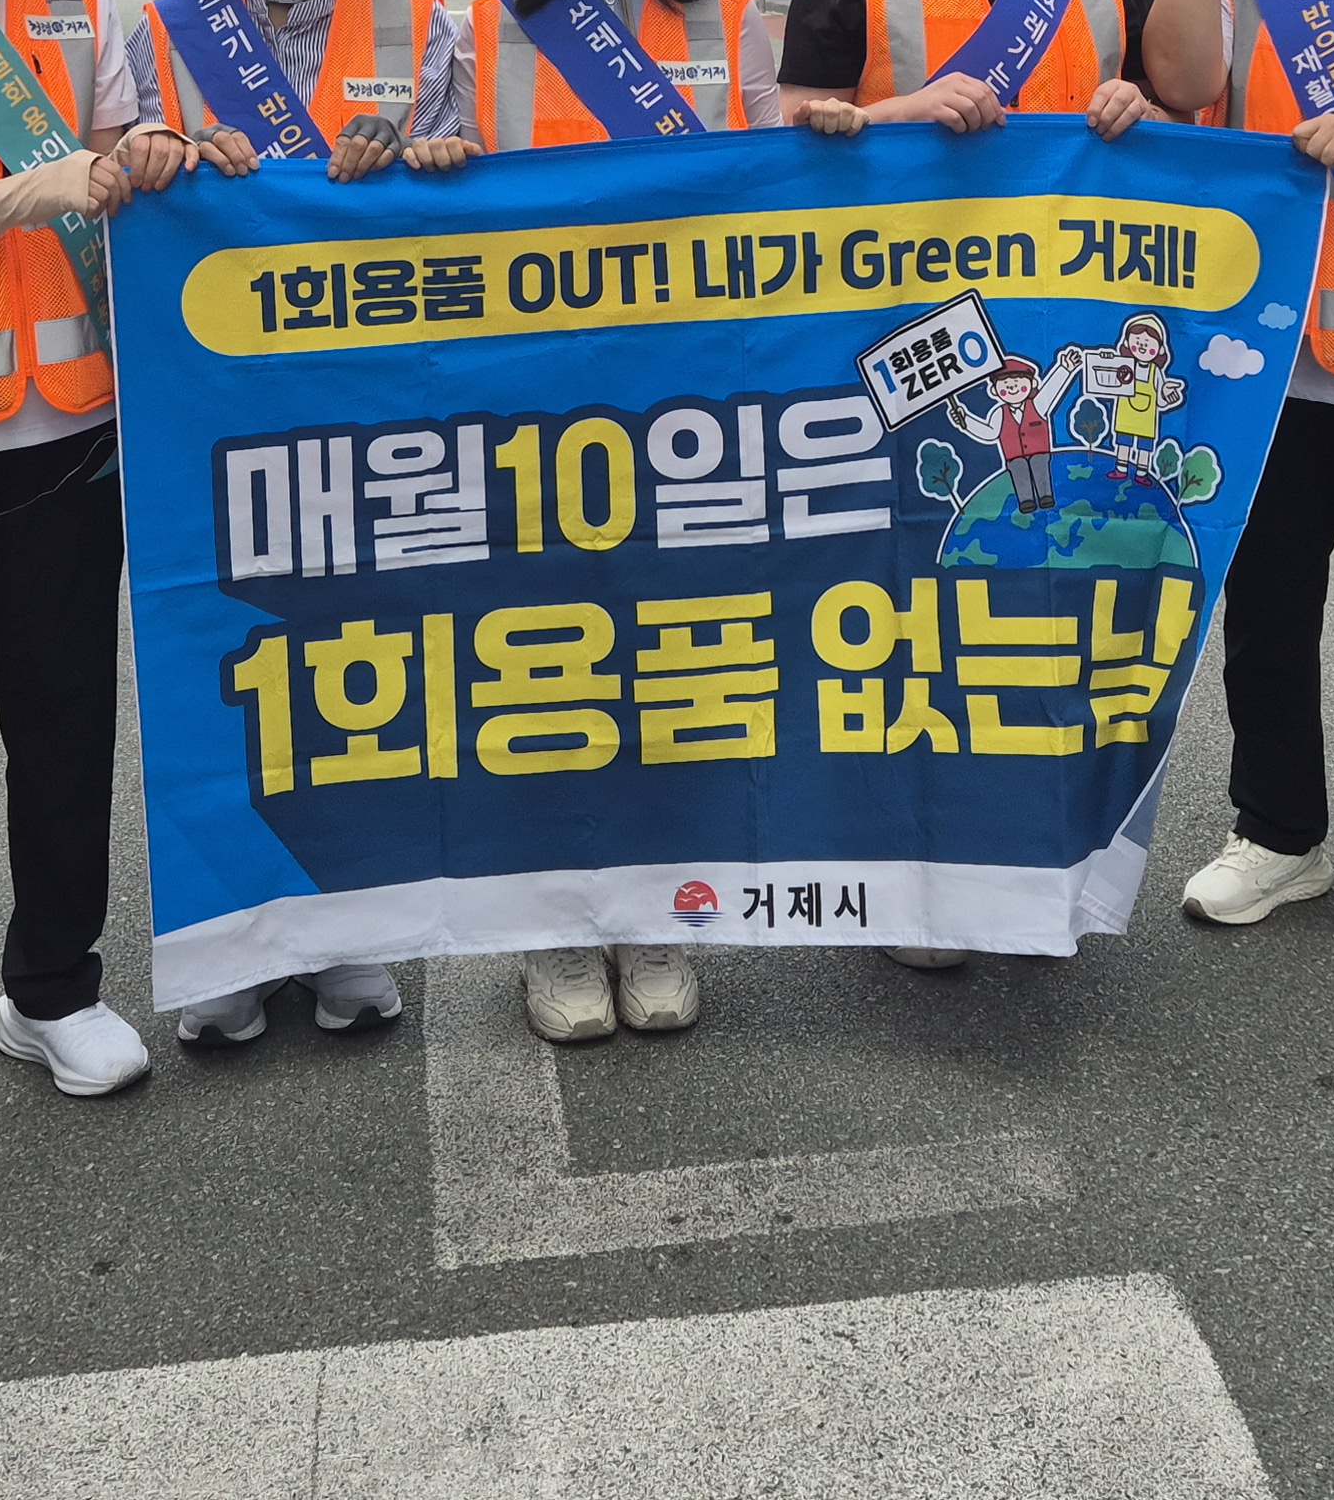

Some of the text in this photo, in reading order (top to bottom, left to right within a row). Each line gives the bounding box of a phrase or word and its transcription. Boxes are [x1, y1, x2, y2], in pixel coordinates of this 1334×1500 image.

[64, 21, 91, 34] 거제
[567, 4, 665, 110] 쓰레기는
[388, 84, 412, 99] 거제
[701, 67, 726, 80] 거제
[257, 91, 319, 159] 반으
[250, 219, 1199, 336] 1회용품 OUT! 내가 Green 거제!
[873, 327, 953, 395] 1회용품
[900, 330, 989, 401] ZERO
[226, 393, 891, 581] 매월10일은
[233, 591, 780, 798] 1회용품
[741, 883, 870, 930] 거제시
